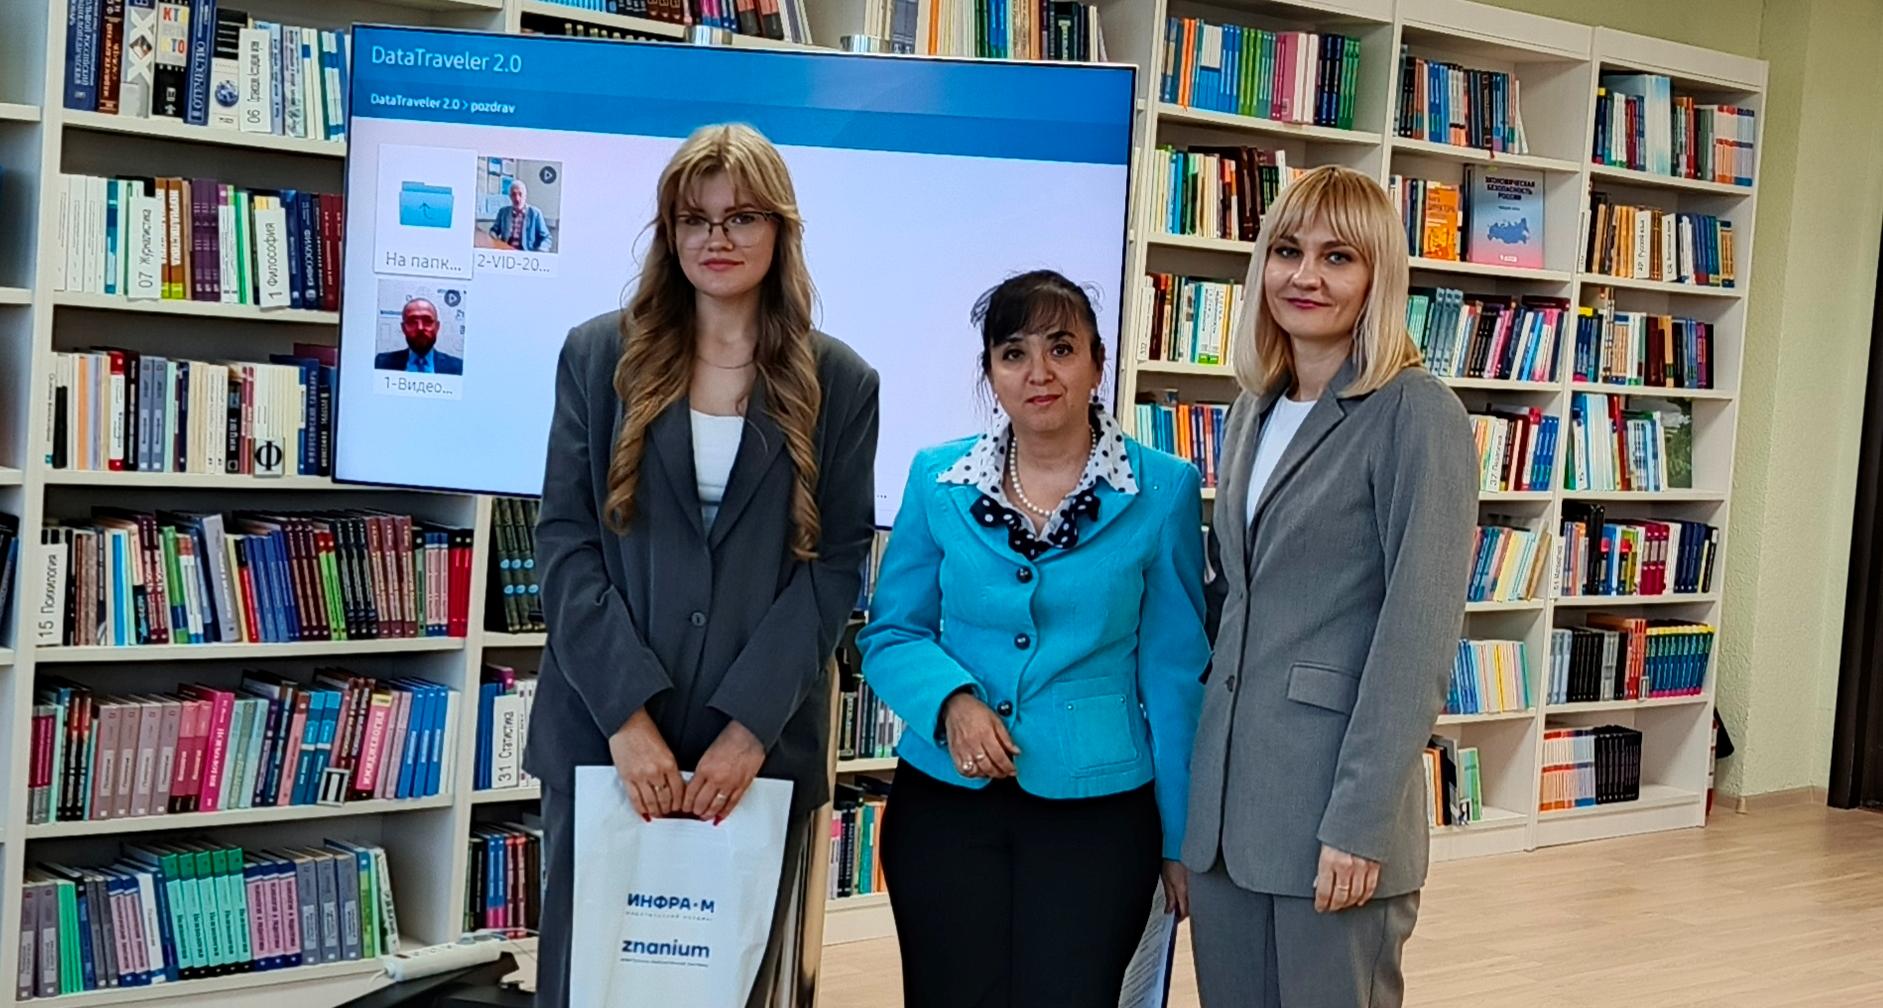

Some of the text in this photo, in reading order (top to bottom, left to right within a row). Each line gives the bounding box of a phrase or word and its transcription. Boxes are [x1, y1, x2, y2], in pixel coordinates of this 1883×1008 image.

[372, 45, 522, 73] DataTraveler 2.0
[370, 93, 516, 114] DataTraveler 2.0 pozdrav
[247, 109, 261, 124] 06
[1485, 176, 1535, 188] ЭКОНОМИЧЕСКАЯ
[1487, 184, 1533, 195] БЕЗОПАСНОСТЬ
[1498, 192, 1521, 200] РОССИИ
[263, 222, 282, 300] 1 Философия
[386, 252, 462, 273] На папк...
[477, 254, 550, 273] 2-VID-20...
[138, 271, 153, 289] 07
[384, 376, 453, 395] 1-Видео...
[254, 440, 283, 472] Ф
[38, 620, 54, 638] 15
[497, 711, 514, 782] 31 Статистика
[622, 939, 710, 958] znanium
